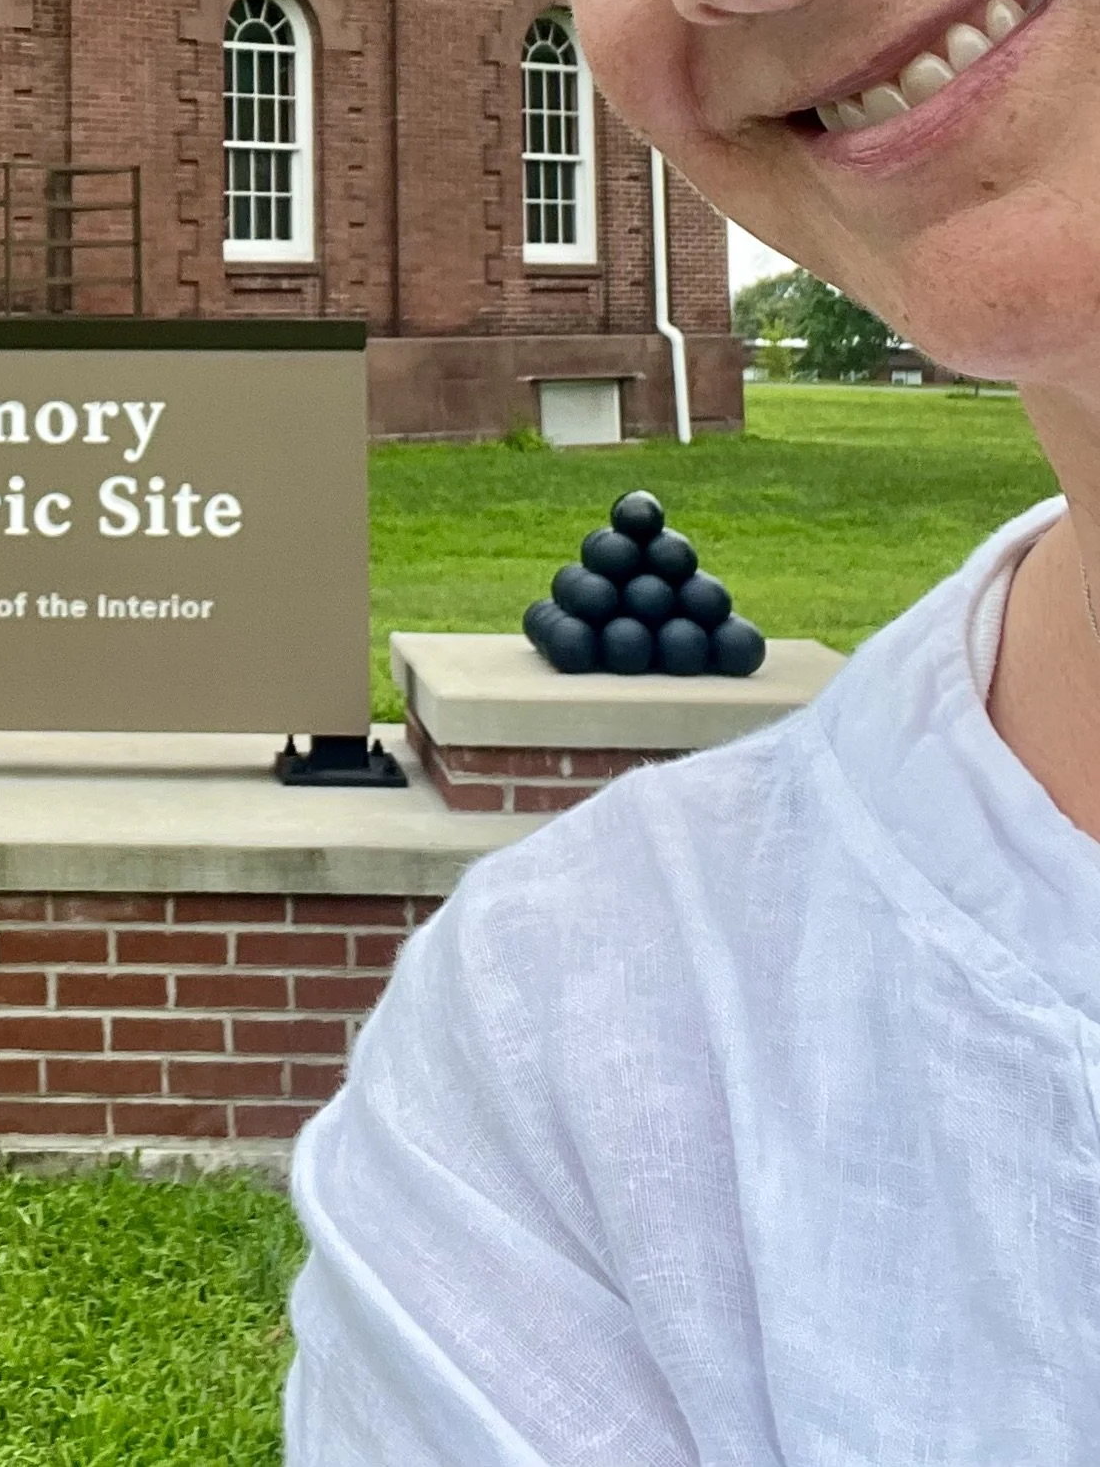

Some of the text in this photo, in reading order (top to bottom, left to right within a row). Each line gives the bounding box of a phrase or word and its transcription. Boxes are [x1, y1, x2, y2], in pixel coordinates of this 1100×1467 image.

[98, 475, 243, 538] Site
[35, 592, 88, 618] the
[97, 594, 214, 619] Interior
